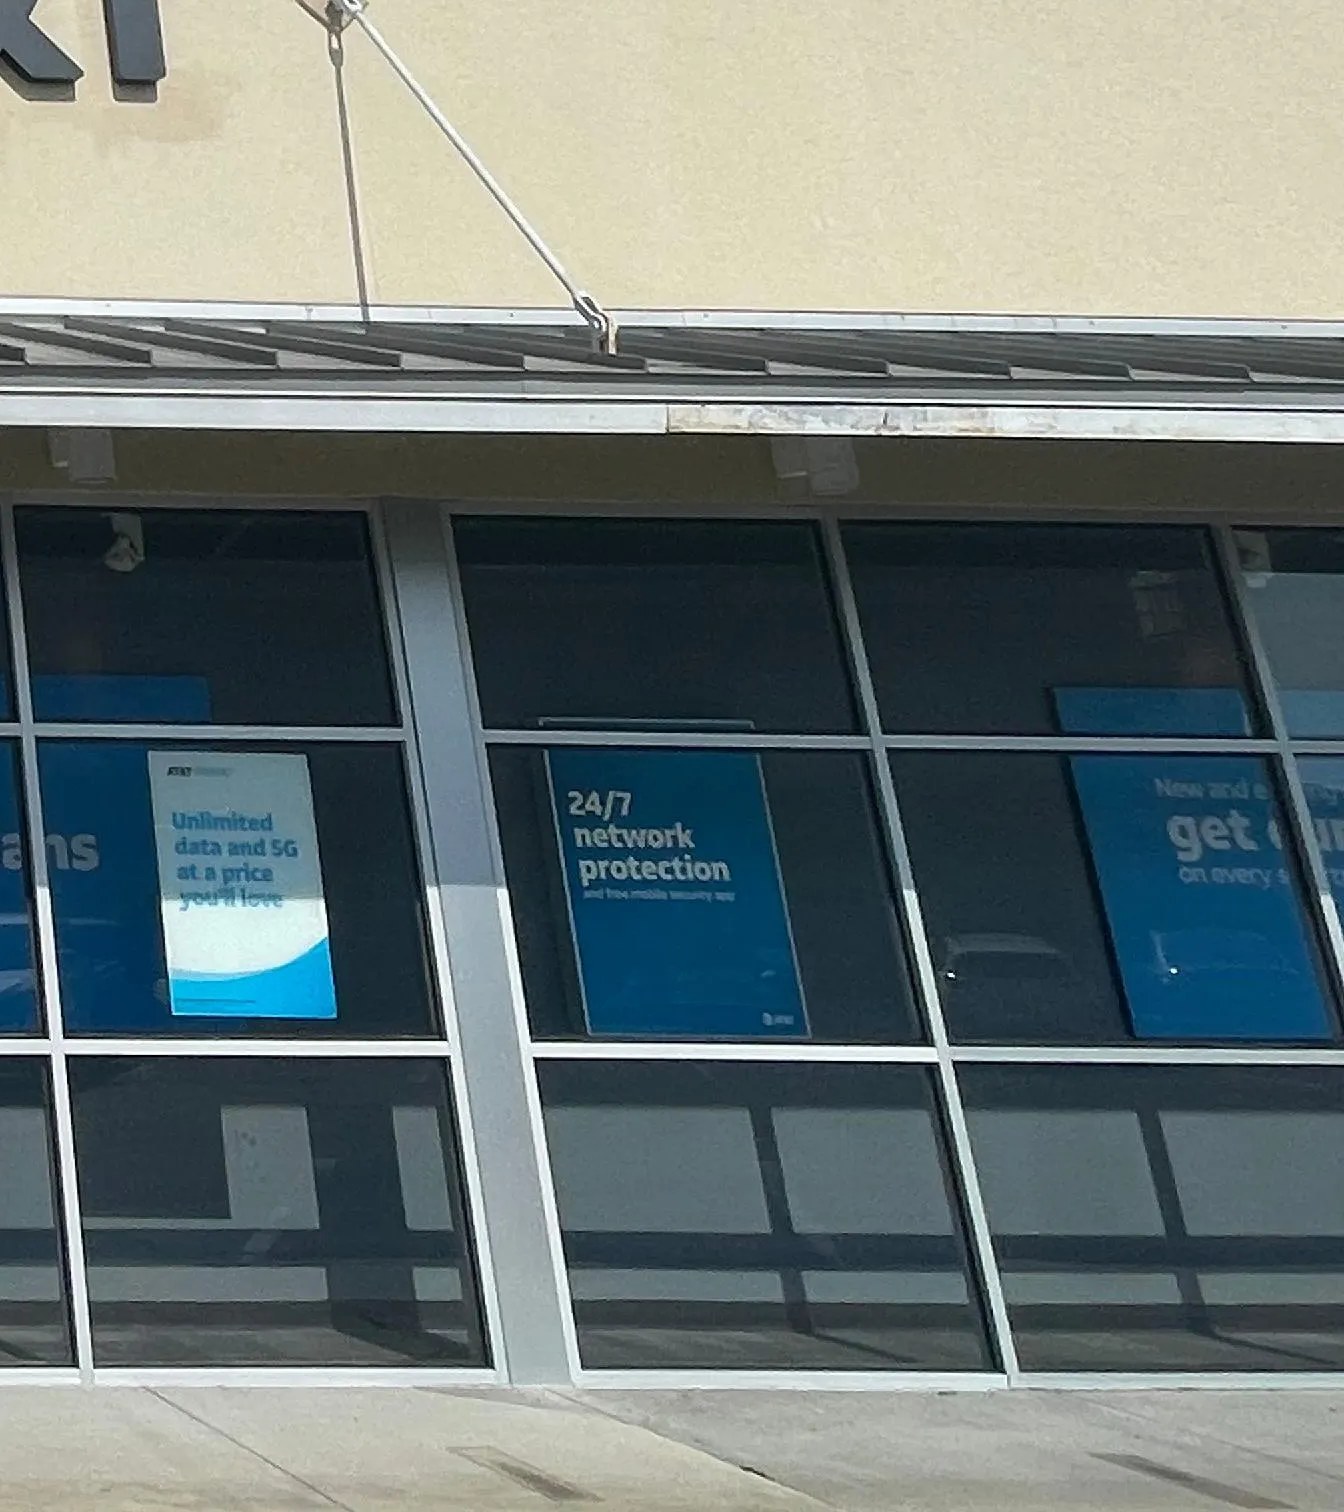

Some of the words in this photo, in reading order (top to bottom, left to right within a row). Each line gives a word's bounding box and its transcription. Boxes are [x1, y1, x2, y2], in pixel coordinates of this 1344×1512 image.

[1154, 777, 1205, 799] New
[1207, 777, 1249, 800] and
[567, 790, 632, 821] 24/7
[171, 810, 274, 832] Unlimited
[174, 836, 222, 857] data
[228, 837, 267, 857] and
[271, 838, 299, 858] 5G
[573, 821, 696, 849] network
[1166, 808, 1260, 863] get
[177, 862, 199, 880] at
[204, 865, 216, 881] a
[222, 862, 274, 885] price
[578, 854, 732, 887] protection
[1178, 865, 1208, 885] on
[1211, 865, 1274, 891] every
